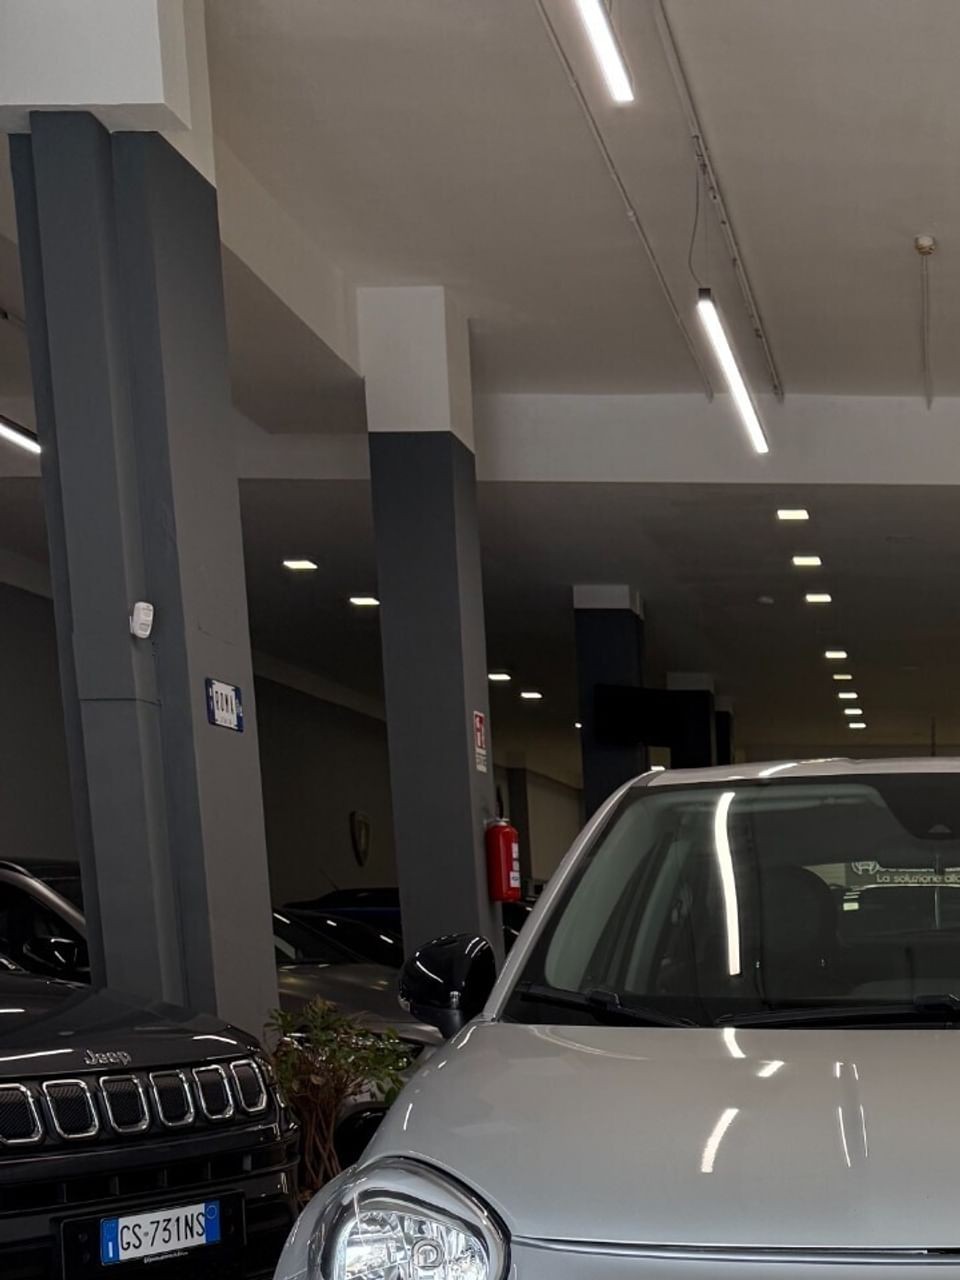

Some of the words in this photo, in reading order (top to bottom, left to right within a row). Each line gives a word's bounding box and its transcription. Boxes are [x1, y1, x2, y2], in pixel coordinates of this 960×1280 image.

[876, 873, 890, 883] La
[893, 873, 943, 884] soluzione
[84, 1049, 132, 1066] Jeep
[119, 1222, 143, 1251] GS
[149, 1212, 206, 1247] 731NS
